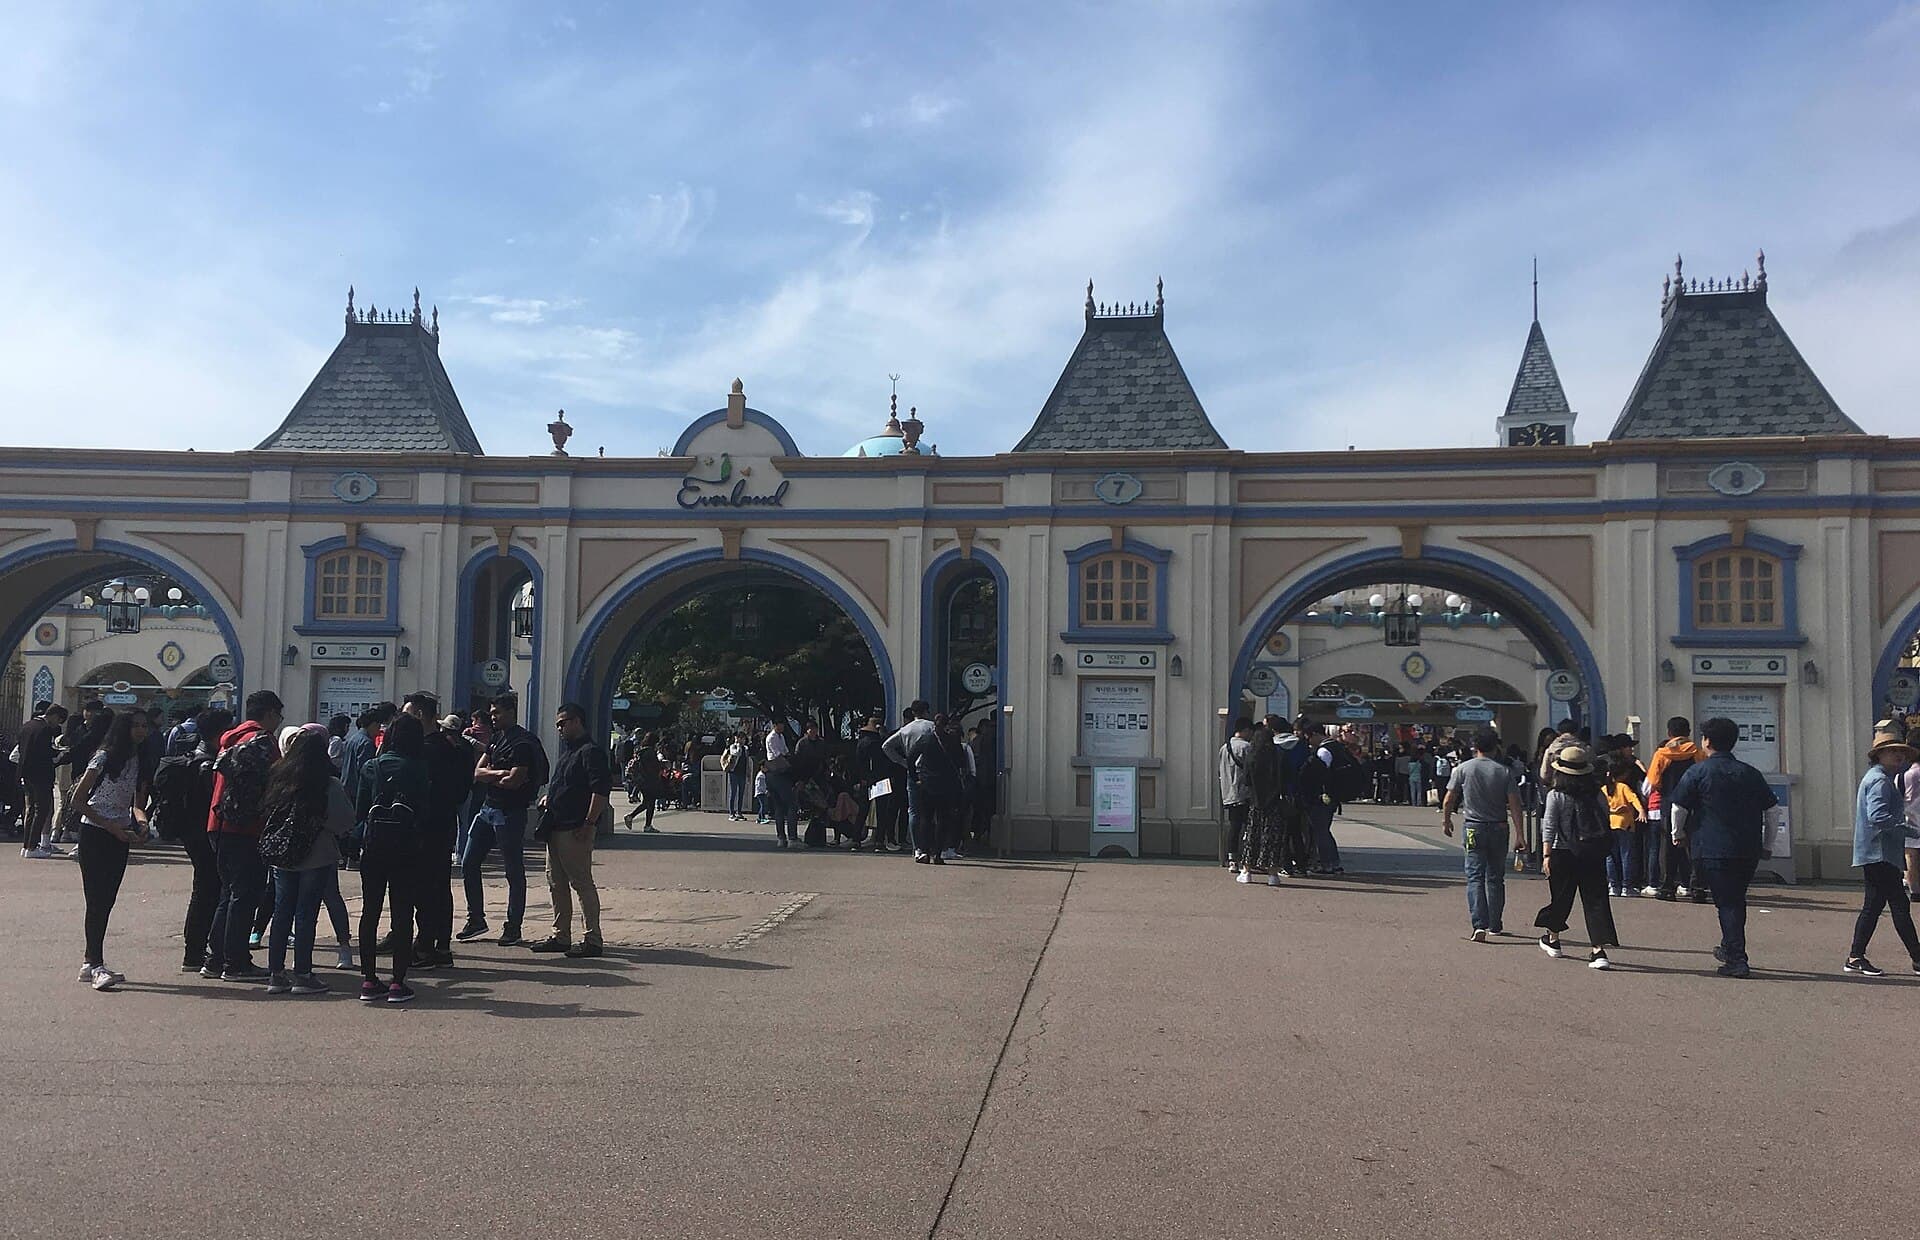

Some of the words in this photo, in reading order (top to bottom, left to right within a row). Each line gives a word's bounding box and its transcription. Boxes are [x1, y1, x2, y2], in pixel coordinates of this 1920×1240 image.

[350, 479, 361, 496] 6
[1730, 470, 1744, 489] 8
[677, 477, 790, 509] Everland
[1112, 480, 1125, 497] 7
[166, 650, 176, 662] 6
[1411, 660, 1421, 673] 2
